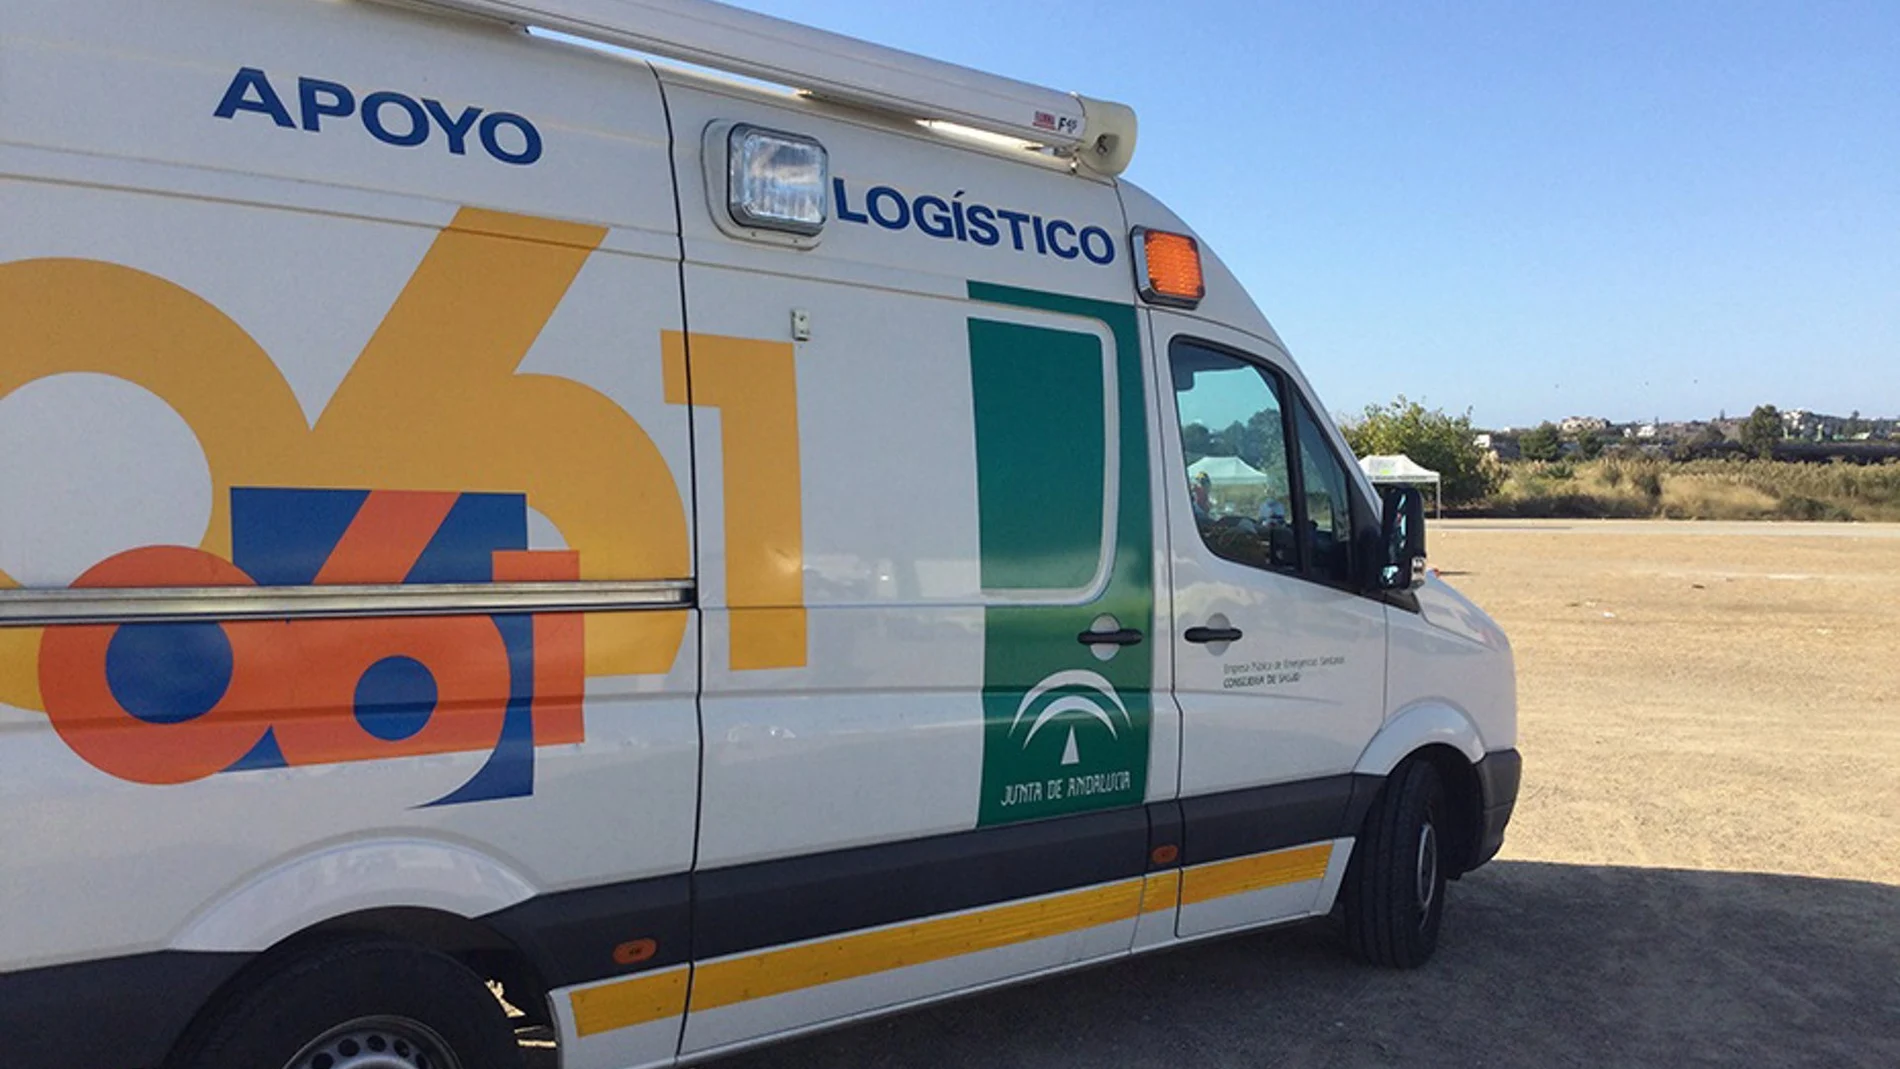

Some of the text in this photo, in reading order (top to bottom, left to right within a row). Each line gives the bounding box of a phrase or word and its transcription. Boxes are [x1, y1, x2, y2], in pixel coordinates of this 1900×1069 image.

[213, 66, 543, 166] APOYO
[832, 176, 1116, 266] LOGÍSTICO
[38, 490, 585, 785] 061
[1267, 674, 1277, 685] DE
[1000, 781, 1042, 807] JUNTA
[1047, 777, 1063, 800] DE
